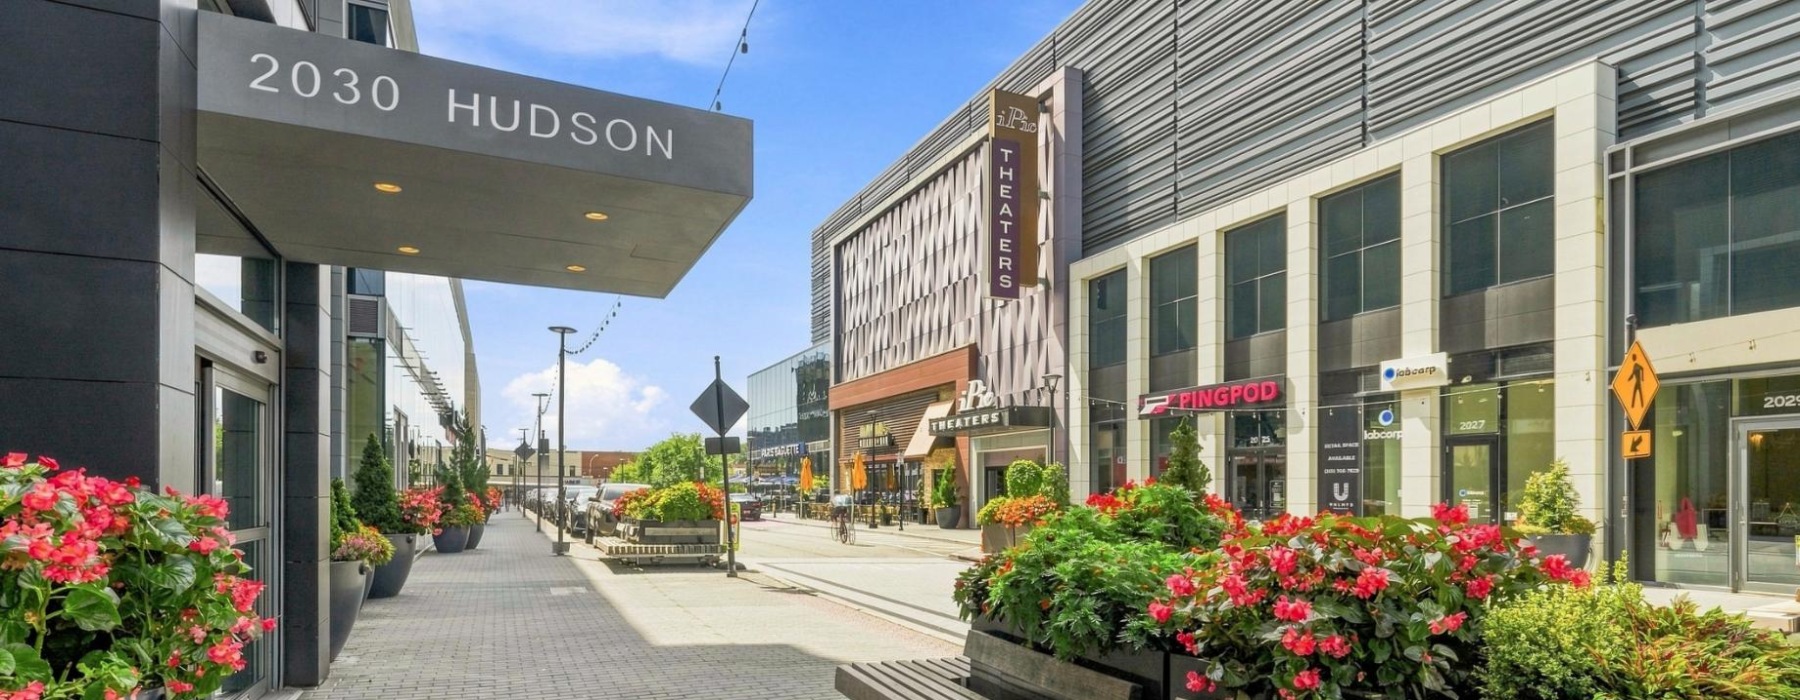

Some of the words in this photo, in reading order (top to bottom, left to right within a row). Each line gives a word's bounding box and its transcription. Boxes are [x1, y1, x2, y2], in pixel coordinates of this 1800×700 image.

[249, 52, 401, 112] 2030
[448, 88, 674, 160] HUDSON
[996, 106, 1038, 134] iPic
[998, 148, 1014, 290] THEATERS
[1396, 366, 1436, 377] labcorp
[958, 380, 998, 412] iPic
[1179, 381, 1278, 409] PINGPOD
[931, 412, 1000, 431] THEATERS
[1459, 420, 1486, 430] 2027
[1364, 430, 1404, 441] labcorp
[1333, 483, 1349, 501] U
